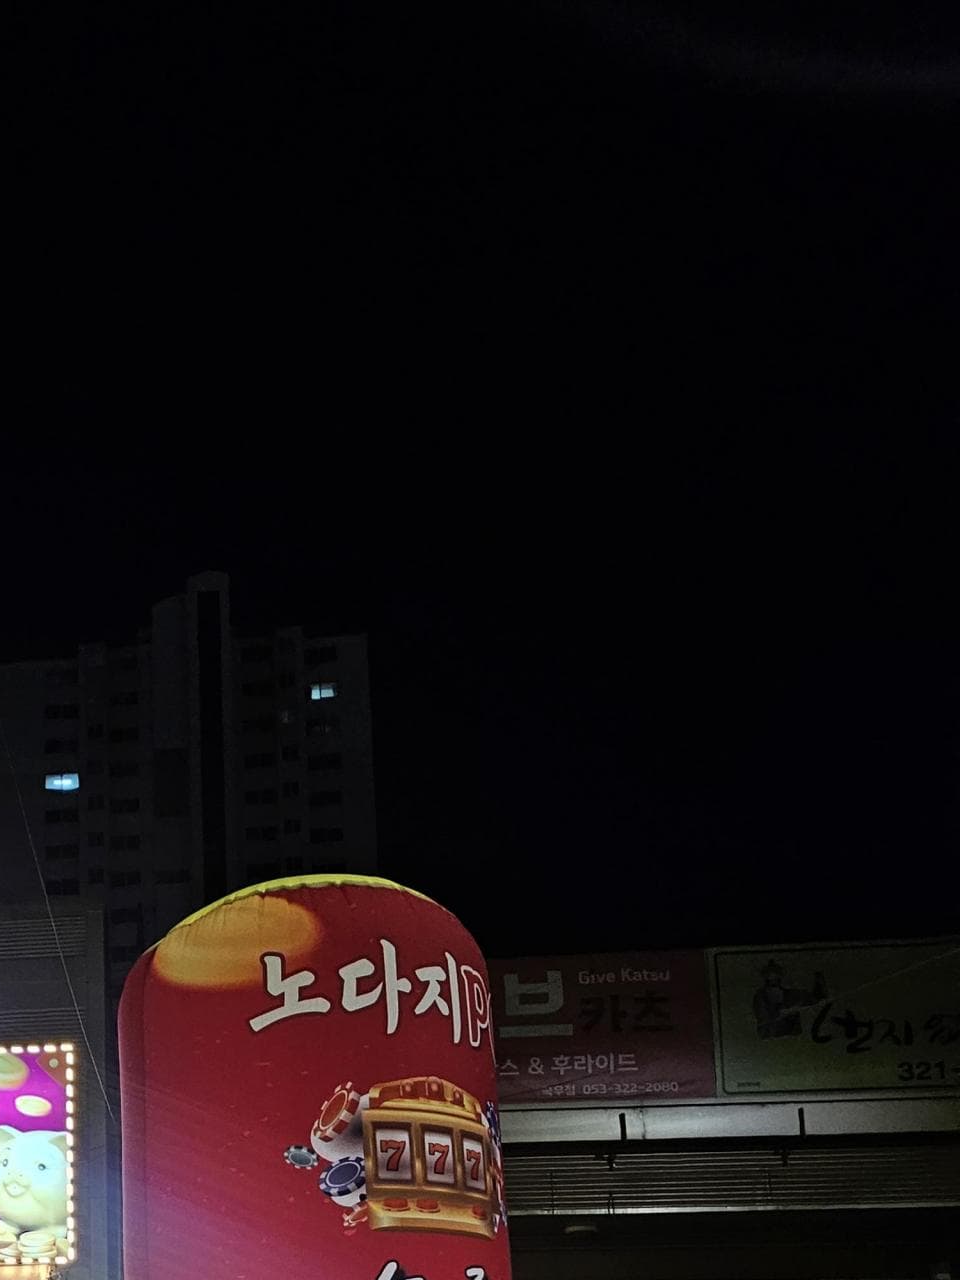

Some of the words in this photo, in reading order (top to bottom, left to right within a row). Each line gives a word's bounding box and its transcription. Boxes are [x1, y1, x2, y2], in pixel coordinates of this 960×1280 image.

[578, 970, 616, 985] Give
[621, 967, 672, 983] Katsu
[249, 938, 494, 1048] 노다지P
[527, 1056, 545, 1075] &
[551, 1052, 640, 1076] 후라이드
